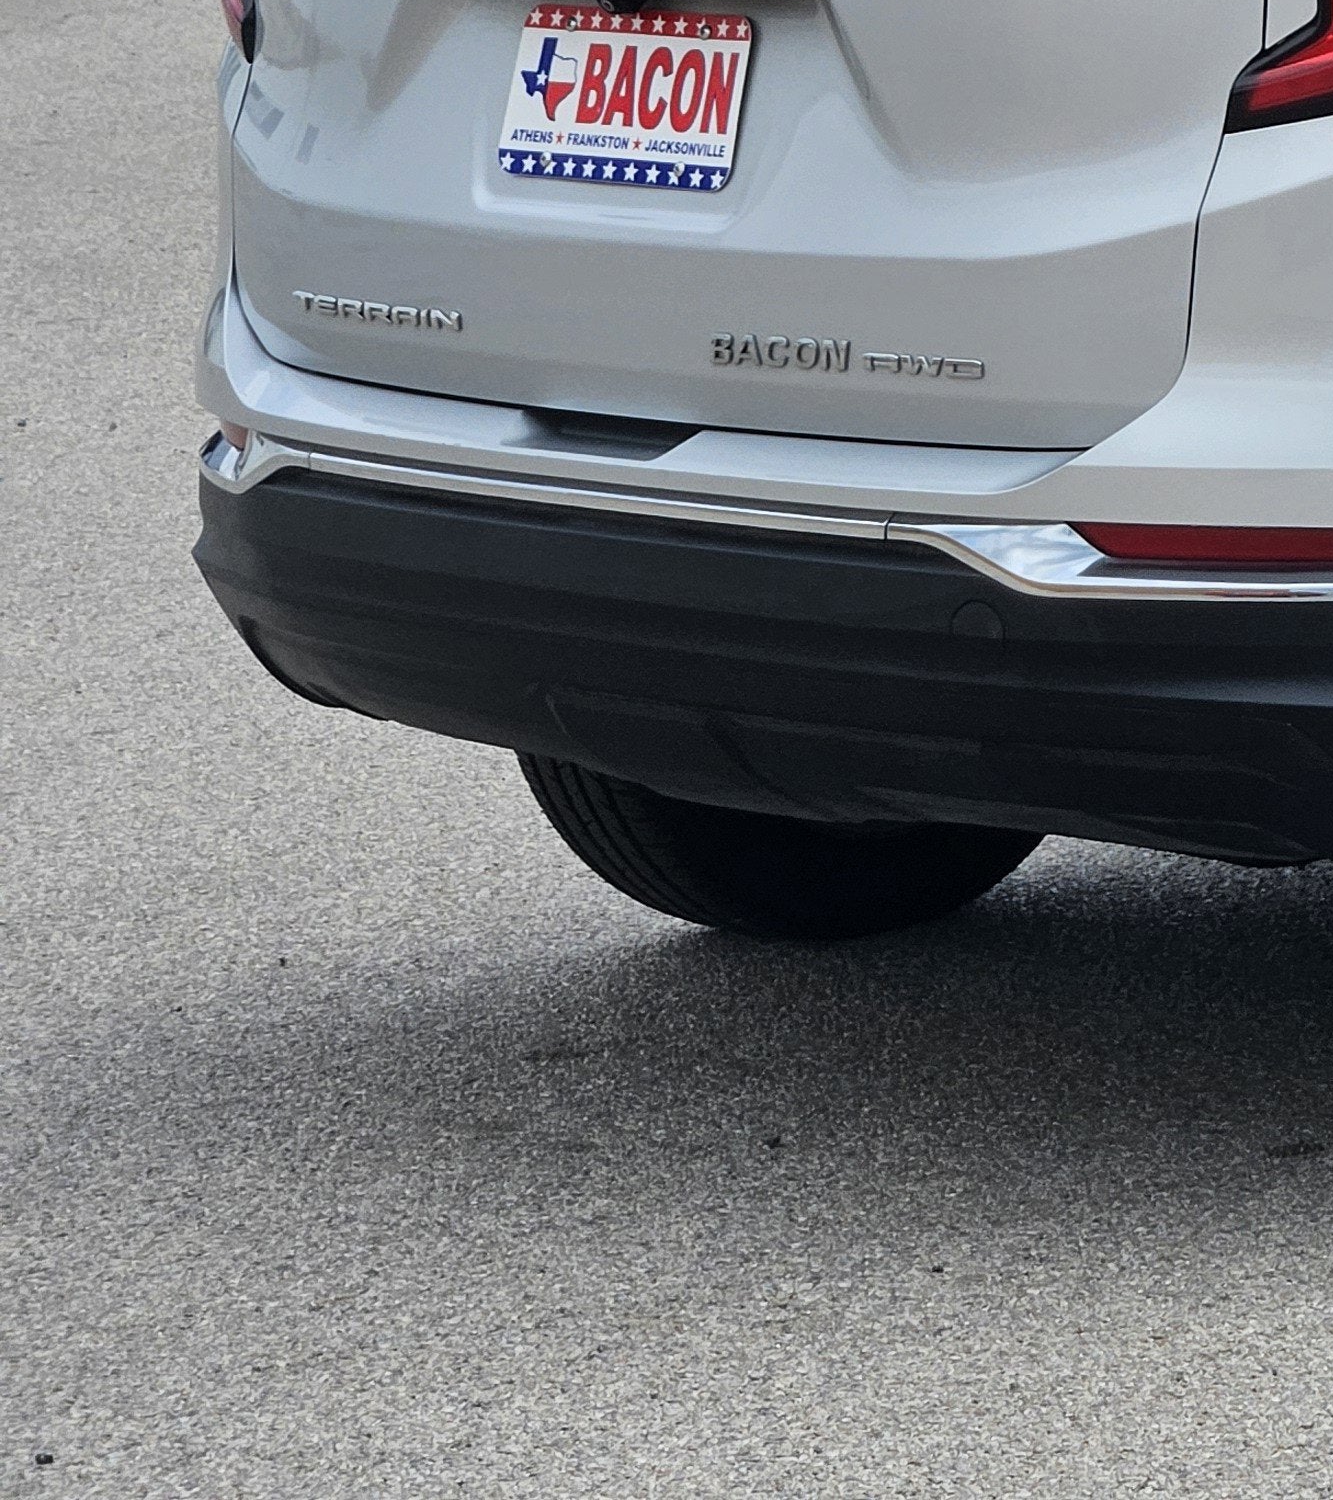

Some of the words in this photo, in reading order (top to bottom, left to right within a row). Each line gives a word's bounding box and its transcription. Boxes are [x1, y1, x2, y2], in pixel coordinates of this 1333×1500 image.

[575, 42, 740, 135] BACON
[510, 128, 554, 145] ATHENS
[566, 132, 630, 151] FRANKSTON
[644, 138, 726, 159] JACKSONVILLE
[292, 290, 464, 332] TERRAIN
[711, 332, 850, 373] BACON
[861, 351, 986, 380] AWD
